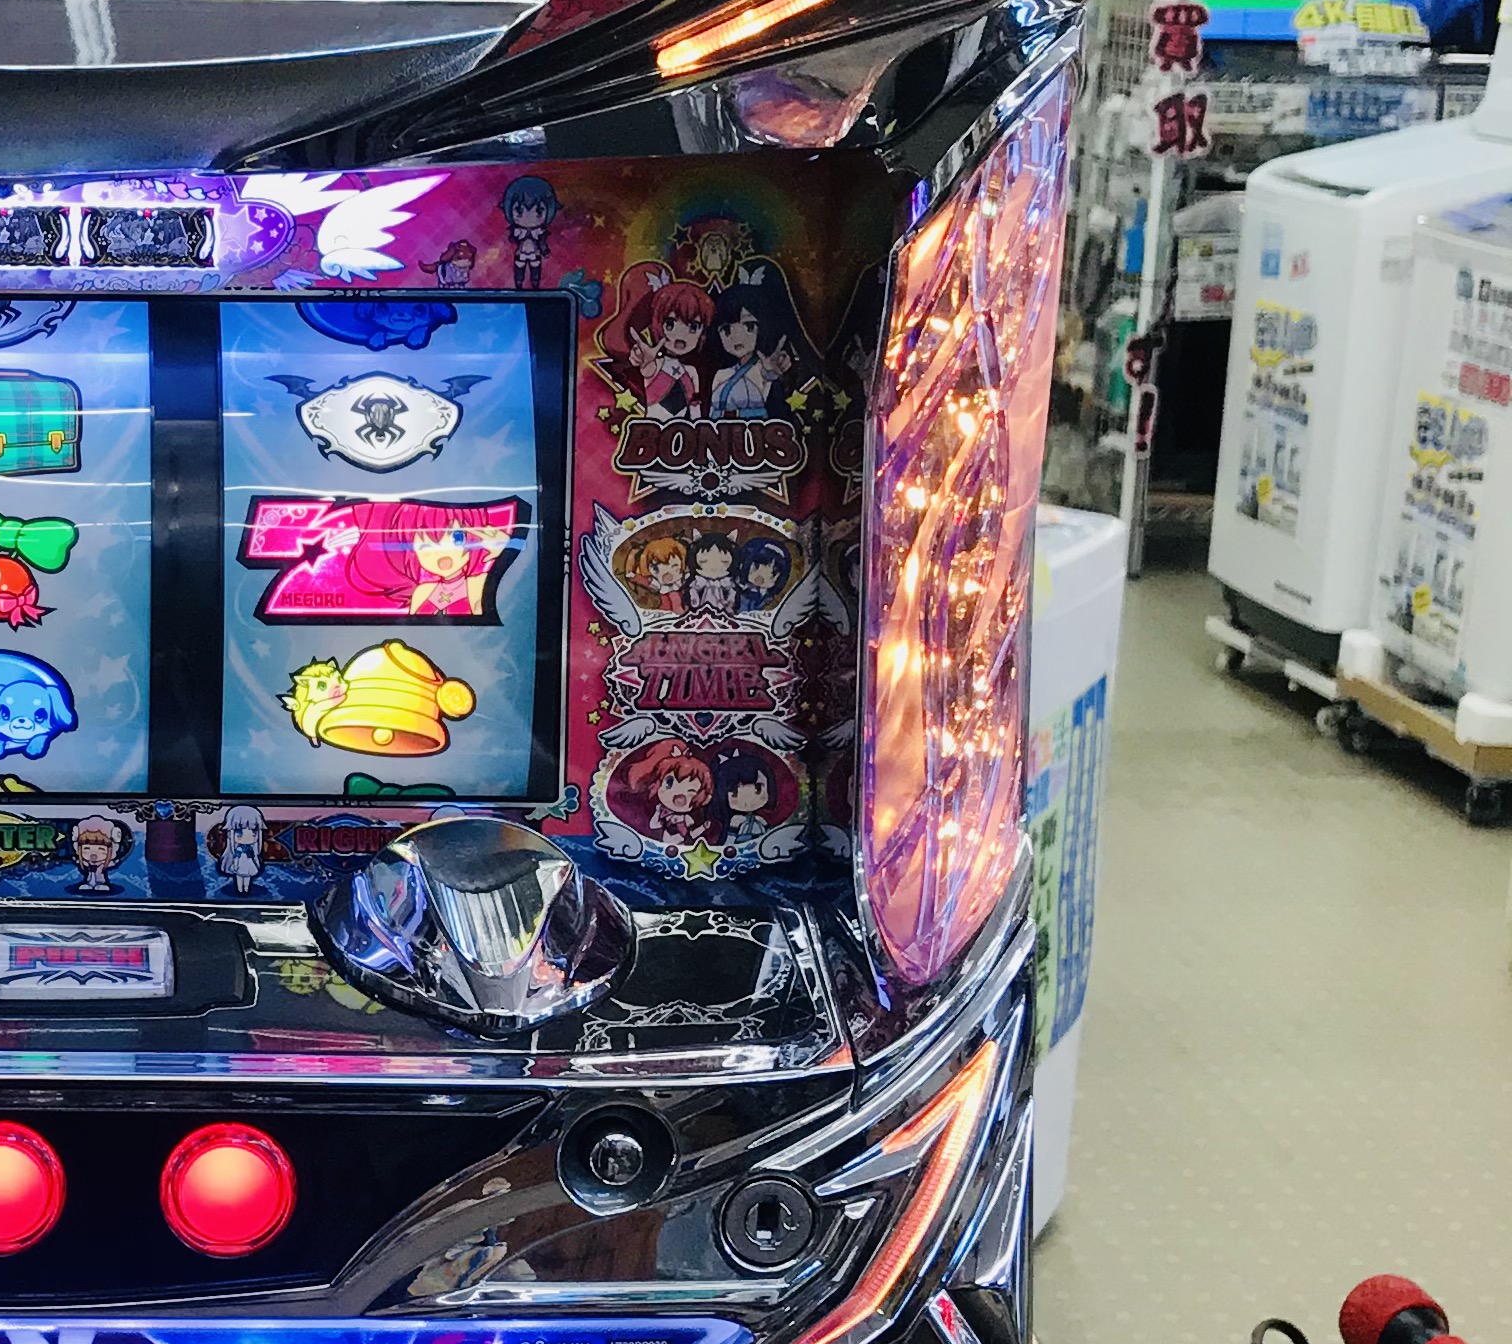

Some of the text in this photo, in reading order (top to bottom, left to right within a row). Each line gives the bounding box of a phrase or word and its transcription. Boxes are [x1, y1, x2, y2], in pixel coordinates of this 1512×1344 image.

[619, 421, 794, 465] BONUS
[642, 666, 775, 708] TIME
[13, 945, 144, 968] PUSH
